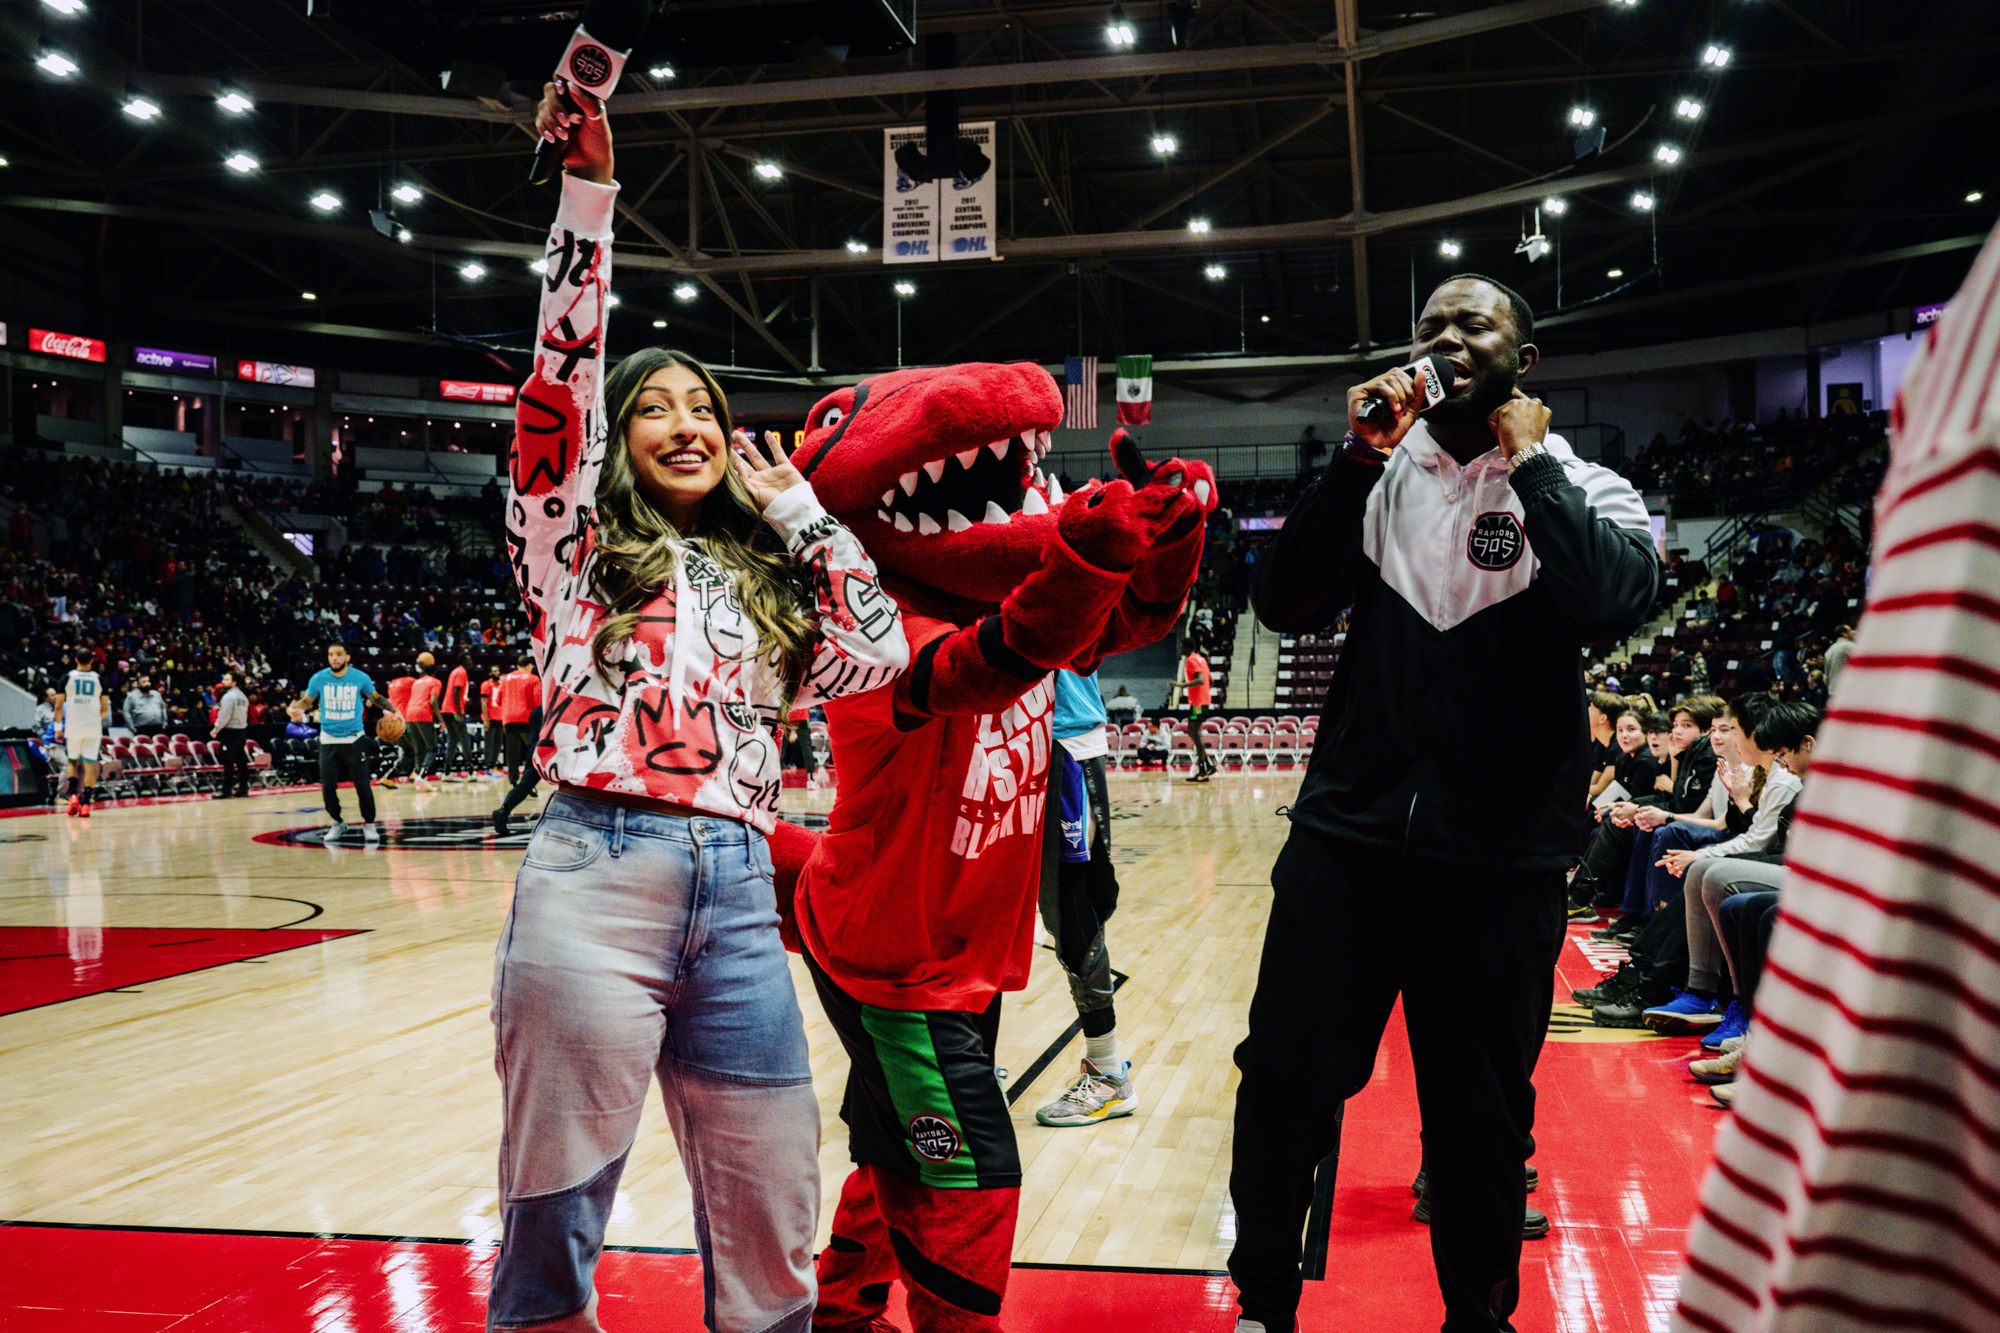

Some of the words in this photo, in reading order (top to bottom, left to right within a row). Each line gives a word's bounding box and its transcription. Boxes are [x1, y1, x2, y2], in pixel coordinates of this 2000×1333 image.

[576, 58, 604, 80] 905
[955, 205, 982, 213] CENTRAL
[954, 214, 983, 222] DIVISION
[950, 222, 987, 231] CHAMPIONS
[136, 352, 173, 367] active
[1477, 528, 1515, 539] RAPTORS
[1474, 537, 1515, 559] 905
[74, 679, 95, 696] 10
[323, 685, 358, 701] BLACK
[916, 1129, 946, 1138] RAPTORS
[918, 1137, 951, 1152] 905
